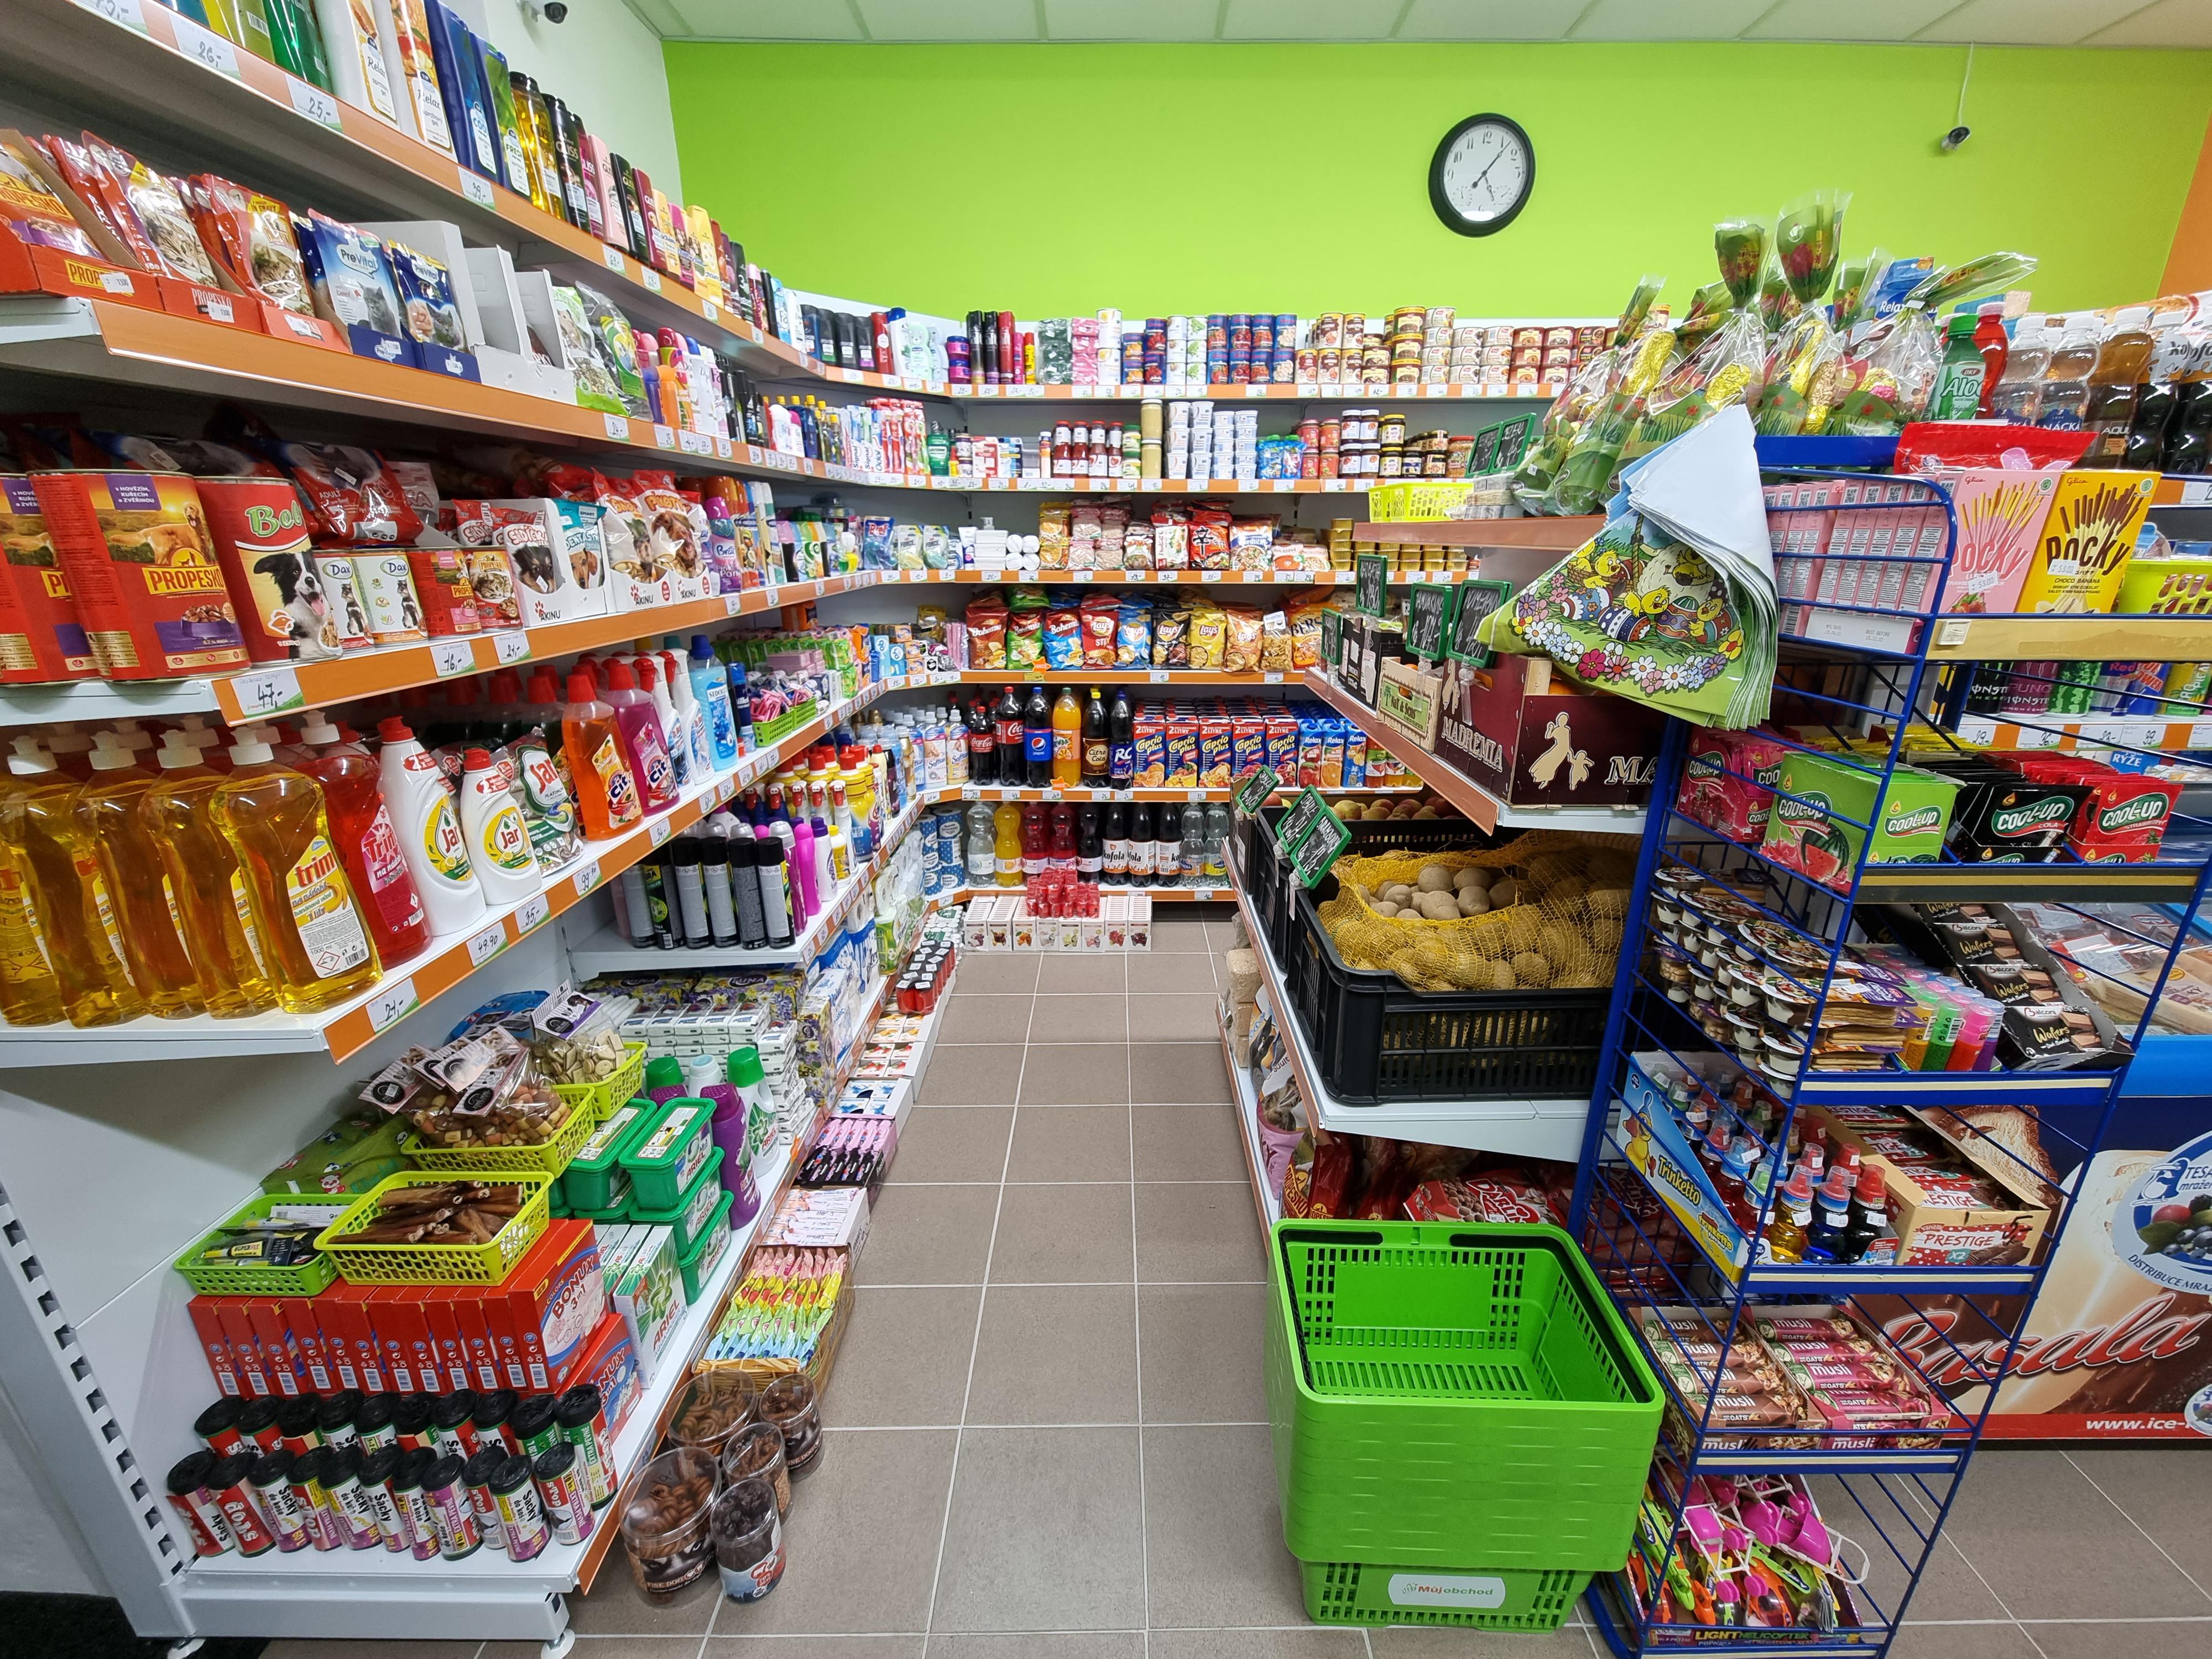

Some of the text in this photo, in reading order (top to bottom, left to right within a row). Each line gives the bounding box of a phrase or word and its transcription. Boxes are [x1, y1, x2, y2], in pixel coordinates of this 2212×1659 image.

[1483, 131, 1493, 144] 12
[340, 248, 378, 270] PreVital
[70, 265, 101, 286] PROP
[331, 564, 351, 575] Dax
[388, 563, 406, 576] Dax
[150, 567, 224, 591] PROPESKO
[635, 594, 654, 606] AKINU
[540, 609, 562, 621] AKINU
[1136, 735, 1162, 753] Caprio
[1169, 735, 1195, 753] Caprio
[1202, 735, 1228, 753] Caprio
[1235, 735, 1261, 753] Caprio
[1269, 734, 1295, 752] Caprio
[1441, 716, 1503, 773] MADREMIA
[1114, 747, 1133, 761] RC
[531, 758, 559, 795] Jar
[610, 776, 628, 798] cit
[1887, 811, 1938, 832] COOL-UP
[1996, 803, 2065, 830] COOL-UP
[2102, 800, 2163, 827] COOL-UP
[362, 832, 397, 864] Trim
[442, 828, 461, 854] Jar
[501, 828, 519, 850] Jar
[1103, 849, 1125, 861] kofola
[295, 850, 336, 888] trim
[1959, 938, 1994, 955] Wafers
[1994, 982, 2030, 998] Wafers
[2033, 1026, 2070, 1044] Wafers
[1273, 1056, 1290, 1073] adult
[1658, 1155, 1701, 1206] Trinketto
[1923, 1233, 1996, 1247] PRESTIGE
[2127, 1253, 2184, 1287] DISTRIBUCE
[552, 1254, 594, 1319] BONUX
[653, 1299, 680, 1352] ARIEL
[1775, 1318, 1812, 1328] musli
[1811, 1363, 1853, 1375] musli
[1713, 1395, 1756, 1407] musli
[2085, 1417, 2190, 1430] www.ice-
[1832, 1437, 1876, 1449] musli
[1695, 1631, 1741, 1640] LIGHT
